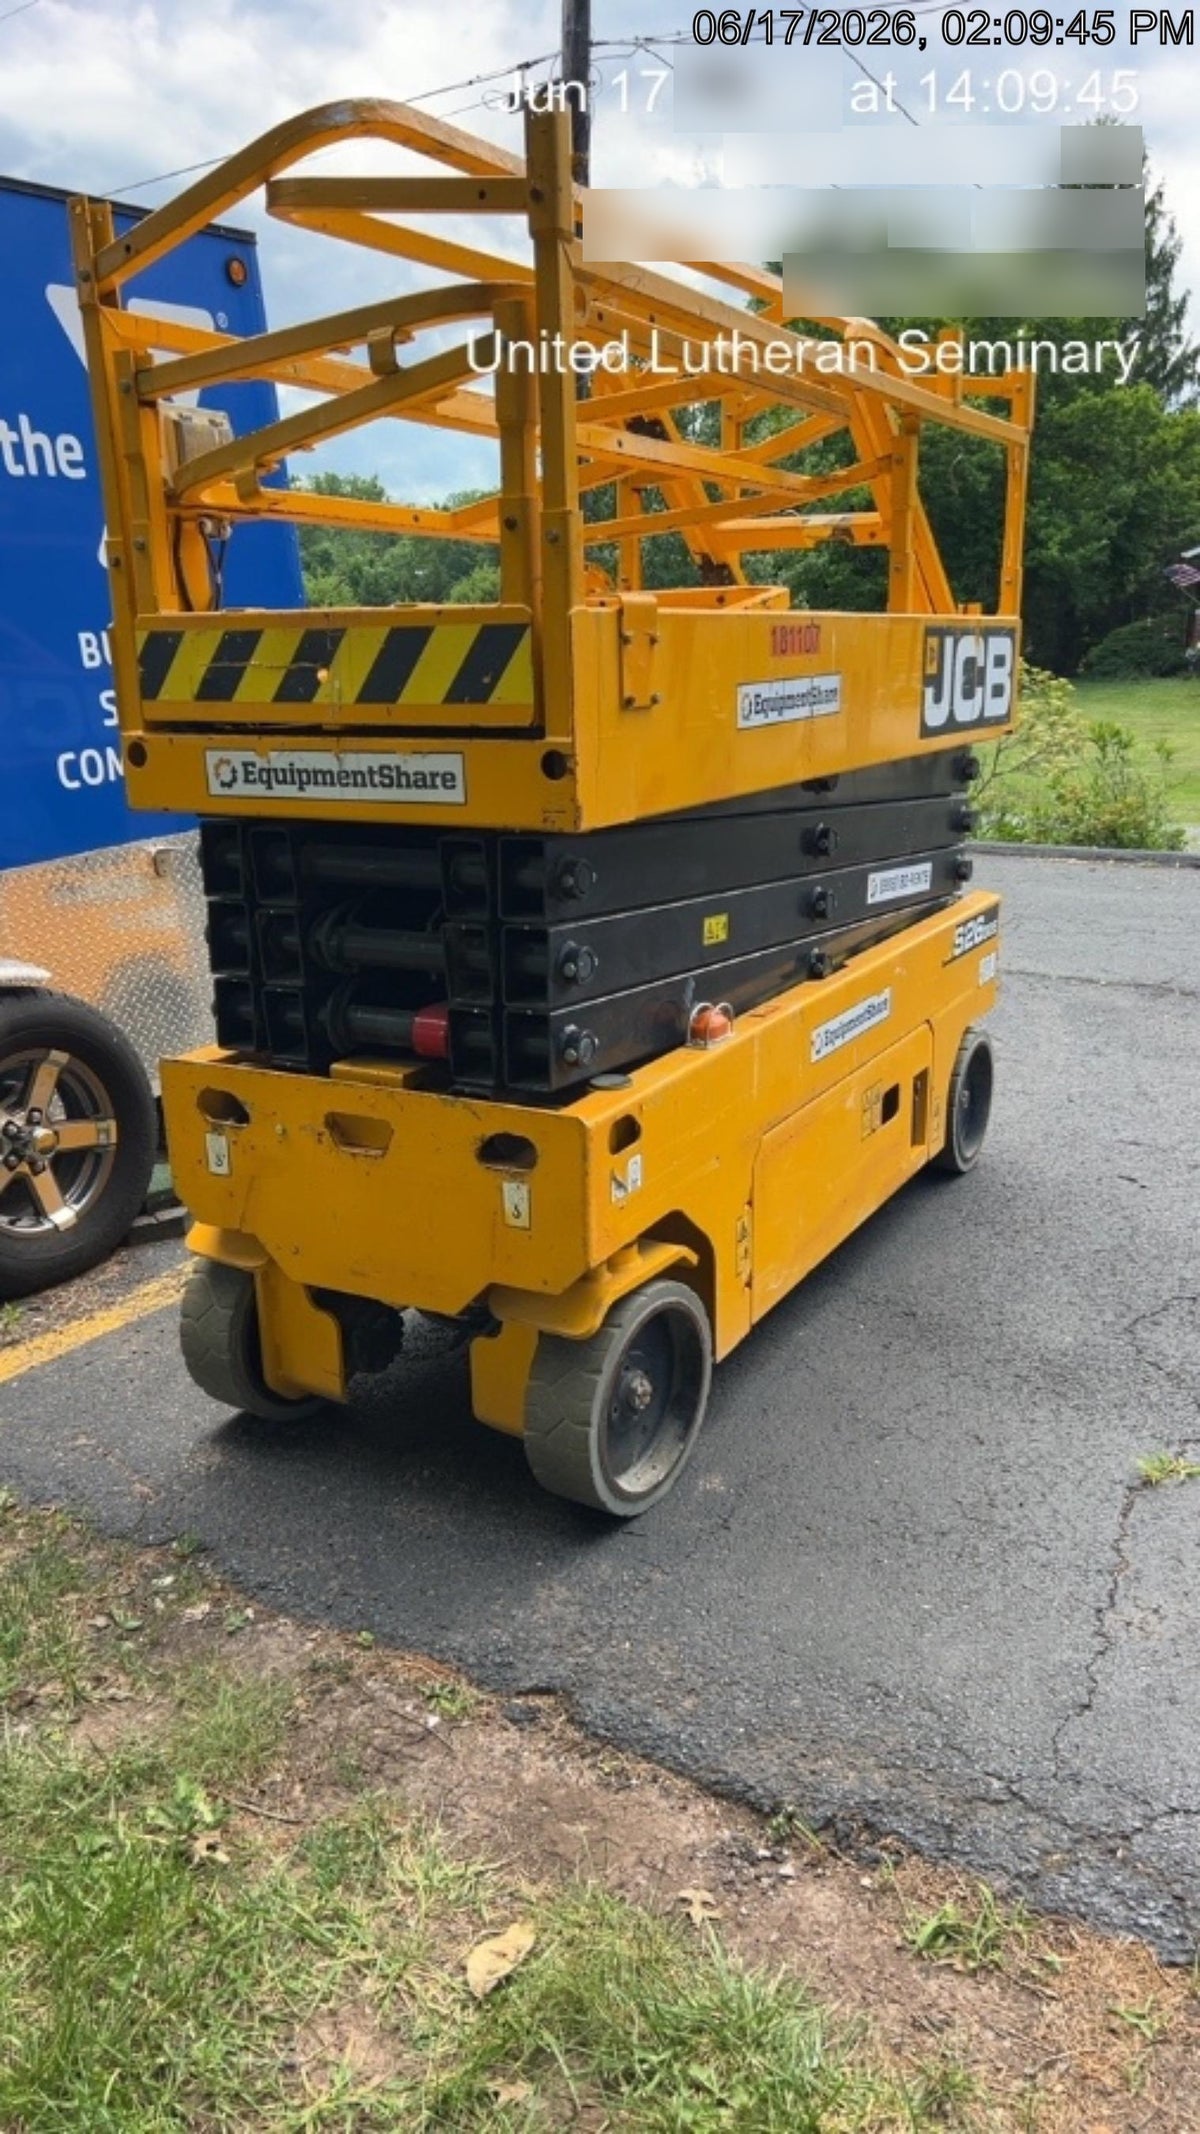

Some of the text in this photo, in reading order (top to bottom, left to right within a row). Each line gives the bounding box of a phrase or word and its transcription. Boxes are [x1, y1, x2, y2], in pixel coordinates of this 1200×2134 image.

[0, 411, 86, 480] the
[753, 685, 838, 719] EquipmentShare
[924, 635, 1013, 727] JCB
[241, 760, 458, 792] EquipmentShare
[822, 997, 887, 1047] EquipmentShare
